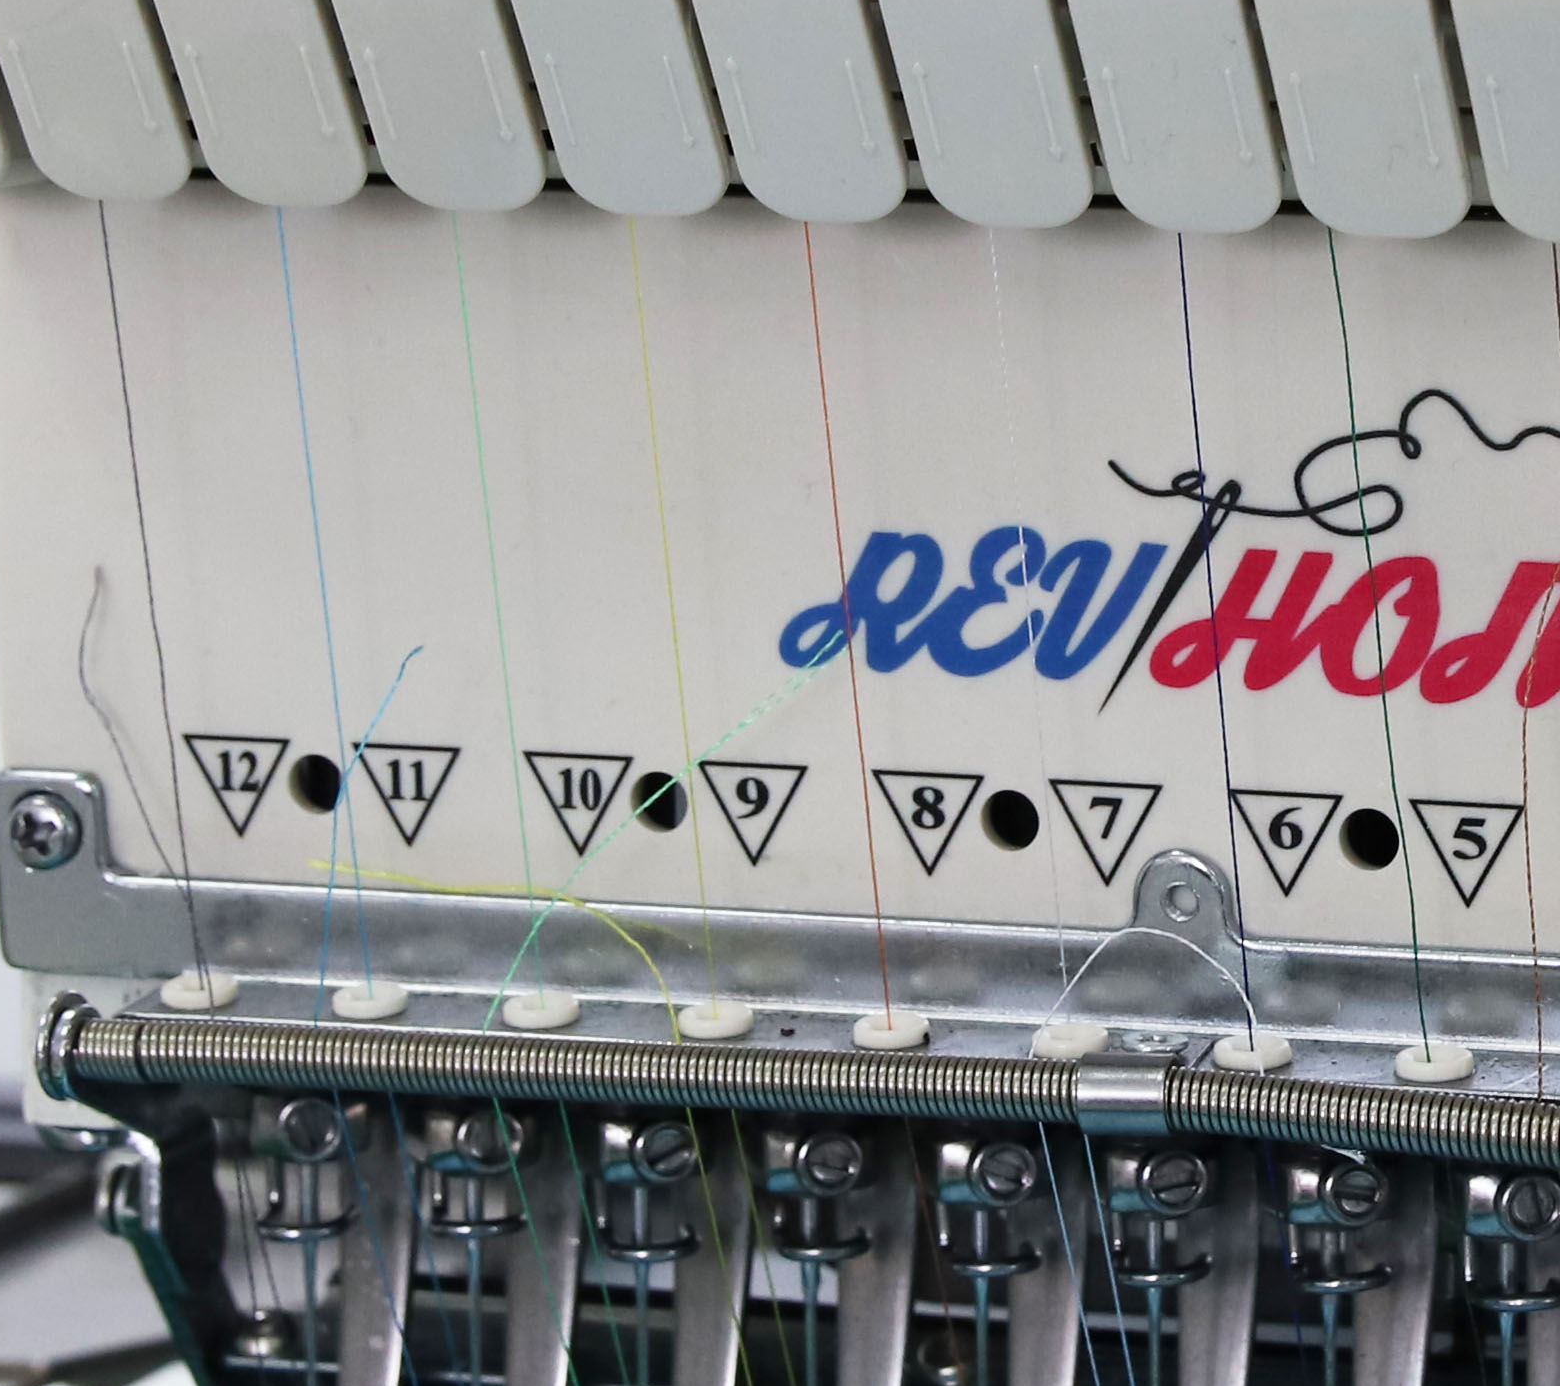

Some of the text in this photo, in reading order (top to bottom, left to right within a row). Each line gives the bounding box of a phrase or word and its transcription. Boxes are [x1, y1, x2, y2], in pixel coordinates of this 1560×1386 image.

[217, 750, 261, 792] 12
[386, 758, 428, 801] 11
[558, 767, 603, 811] 10
[735, 776, 770, 819] 9
[910, 785, 946, 830] 8
[1088, 795, 1124, 840] 7
[1267, 806, 1304, 851] 6
[1451, 816, 1488, 861] 5
